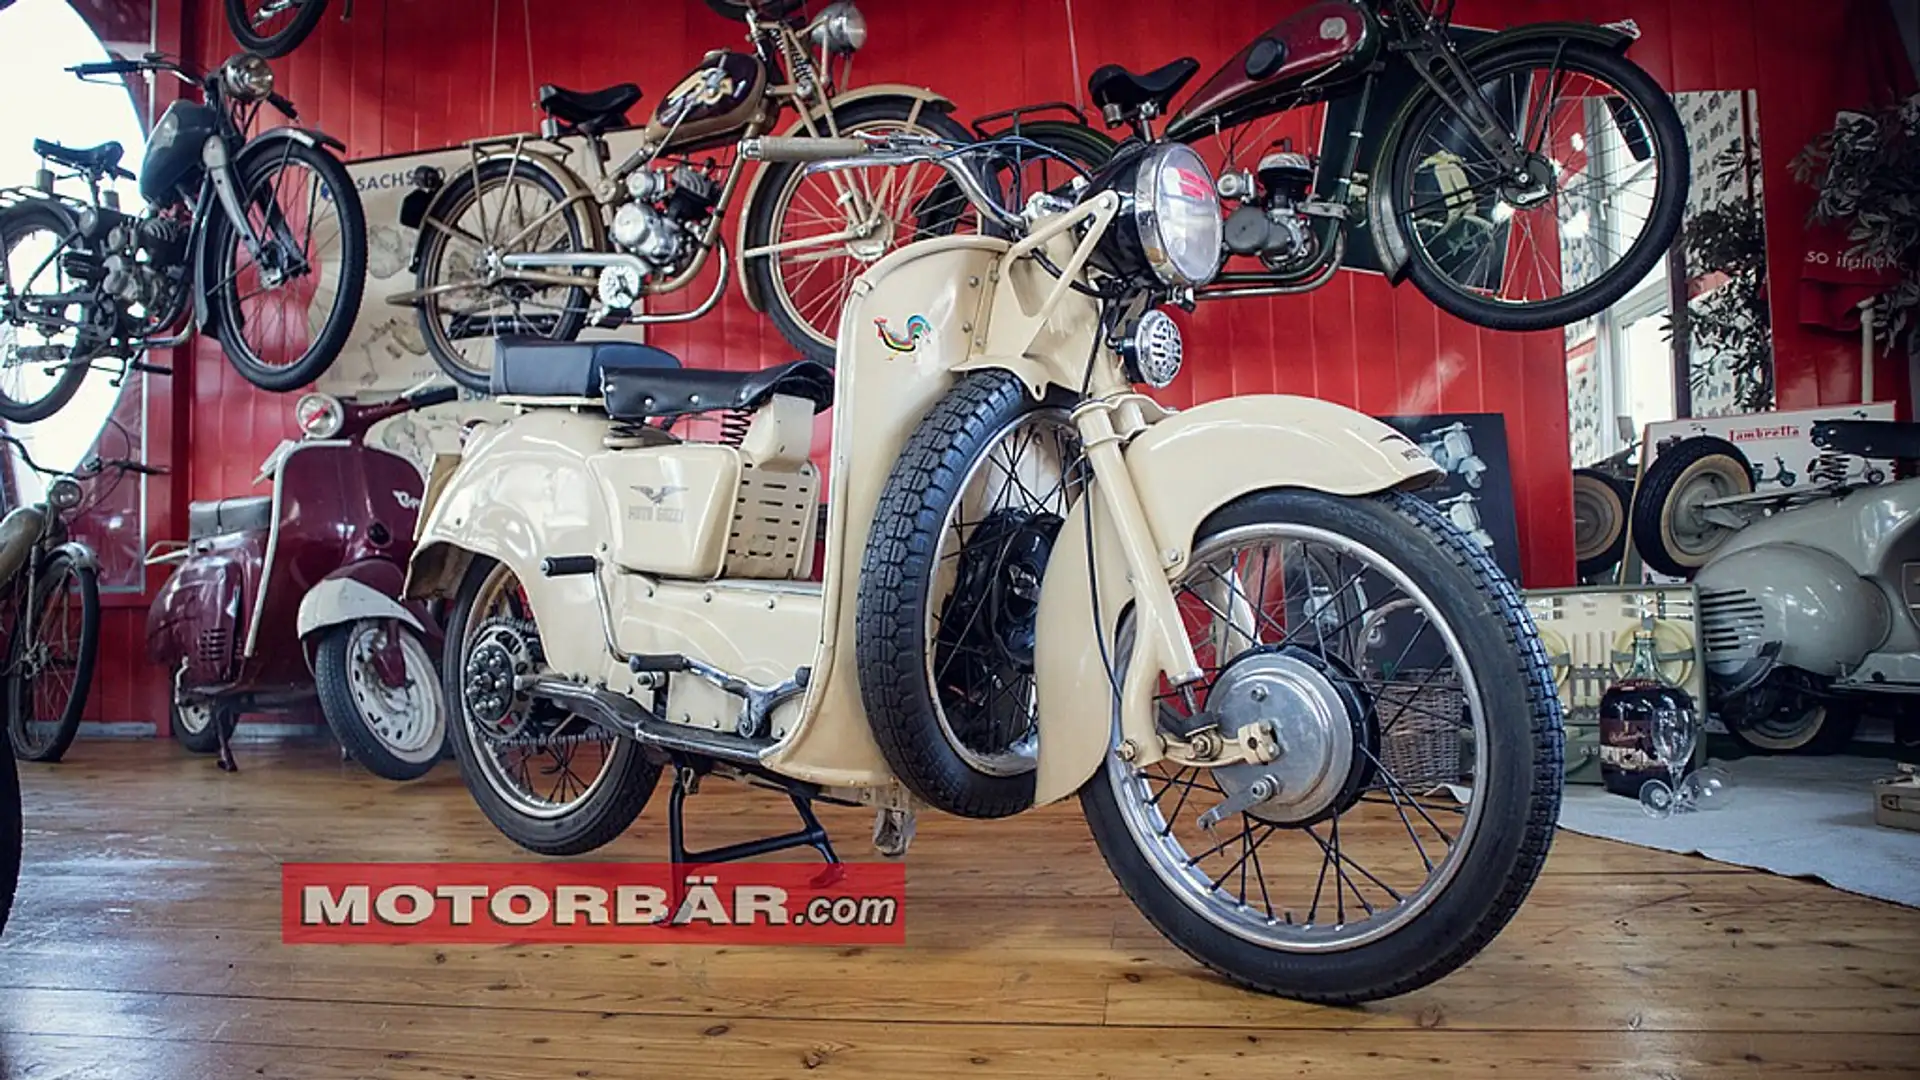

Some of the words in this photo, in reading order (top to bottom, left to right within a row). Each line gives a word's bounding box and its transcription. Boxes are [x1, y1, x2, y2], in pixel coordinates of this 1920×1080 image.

[357, 169, 415, 192] SACHS
[1804, 251, 1829, 265] so
[1728, 425, 1800, 442] Lambretta
